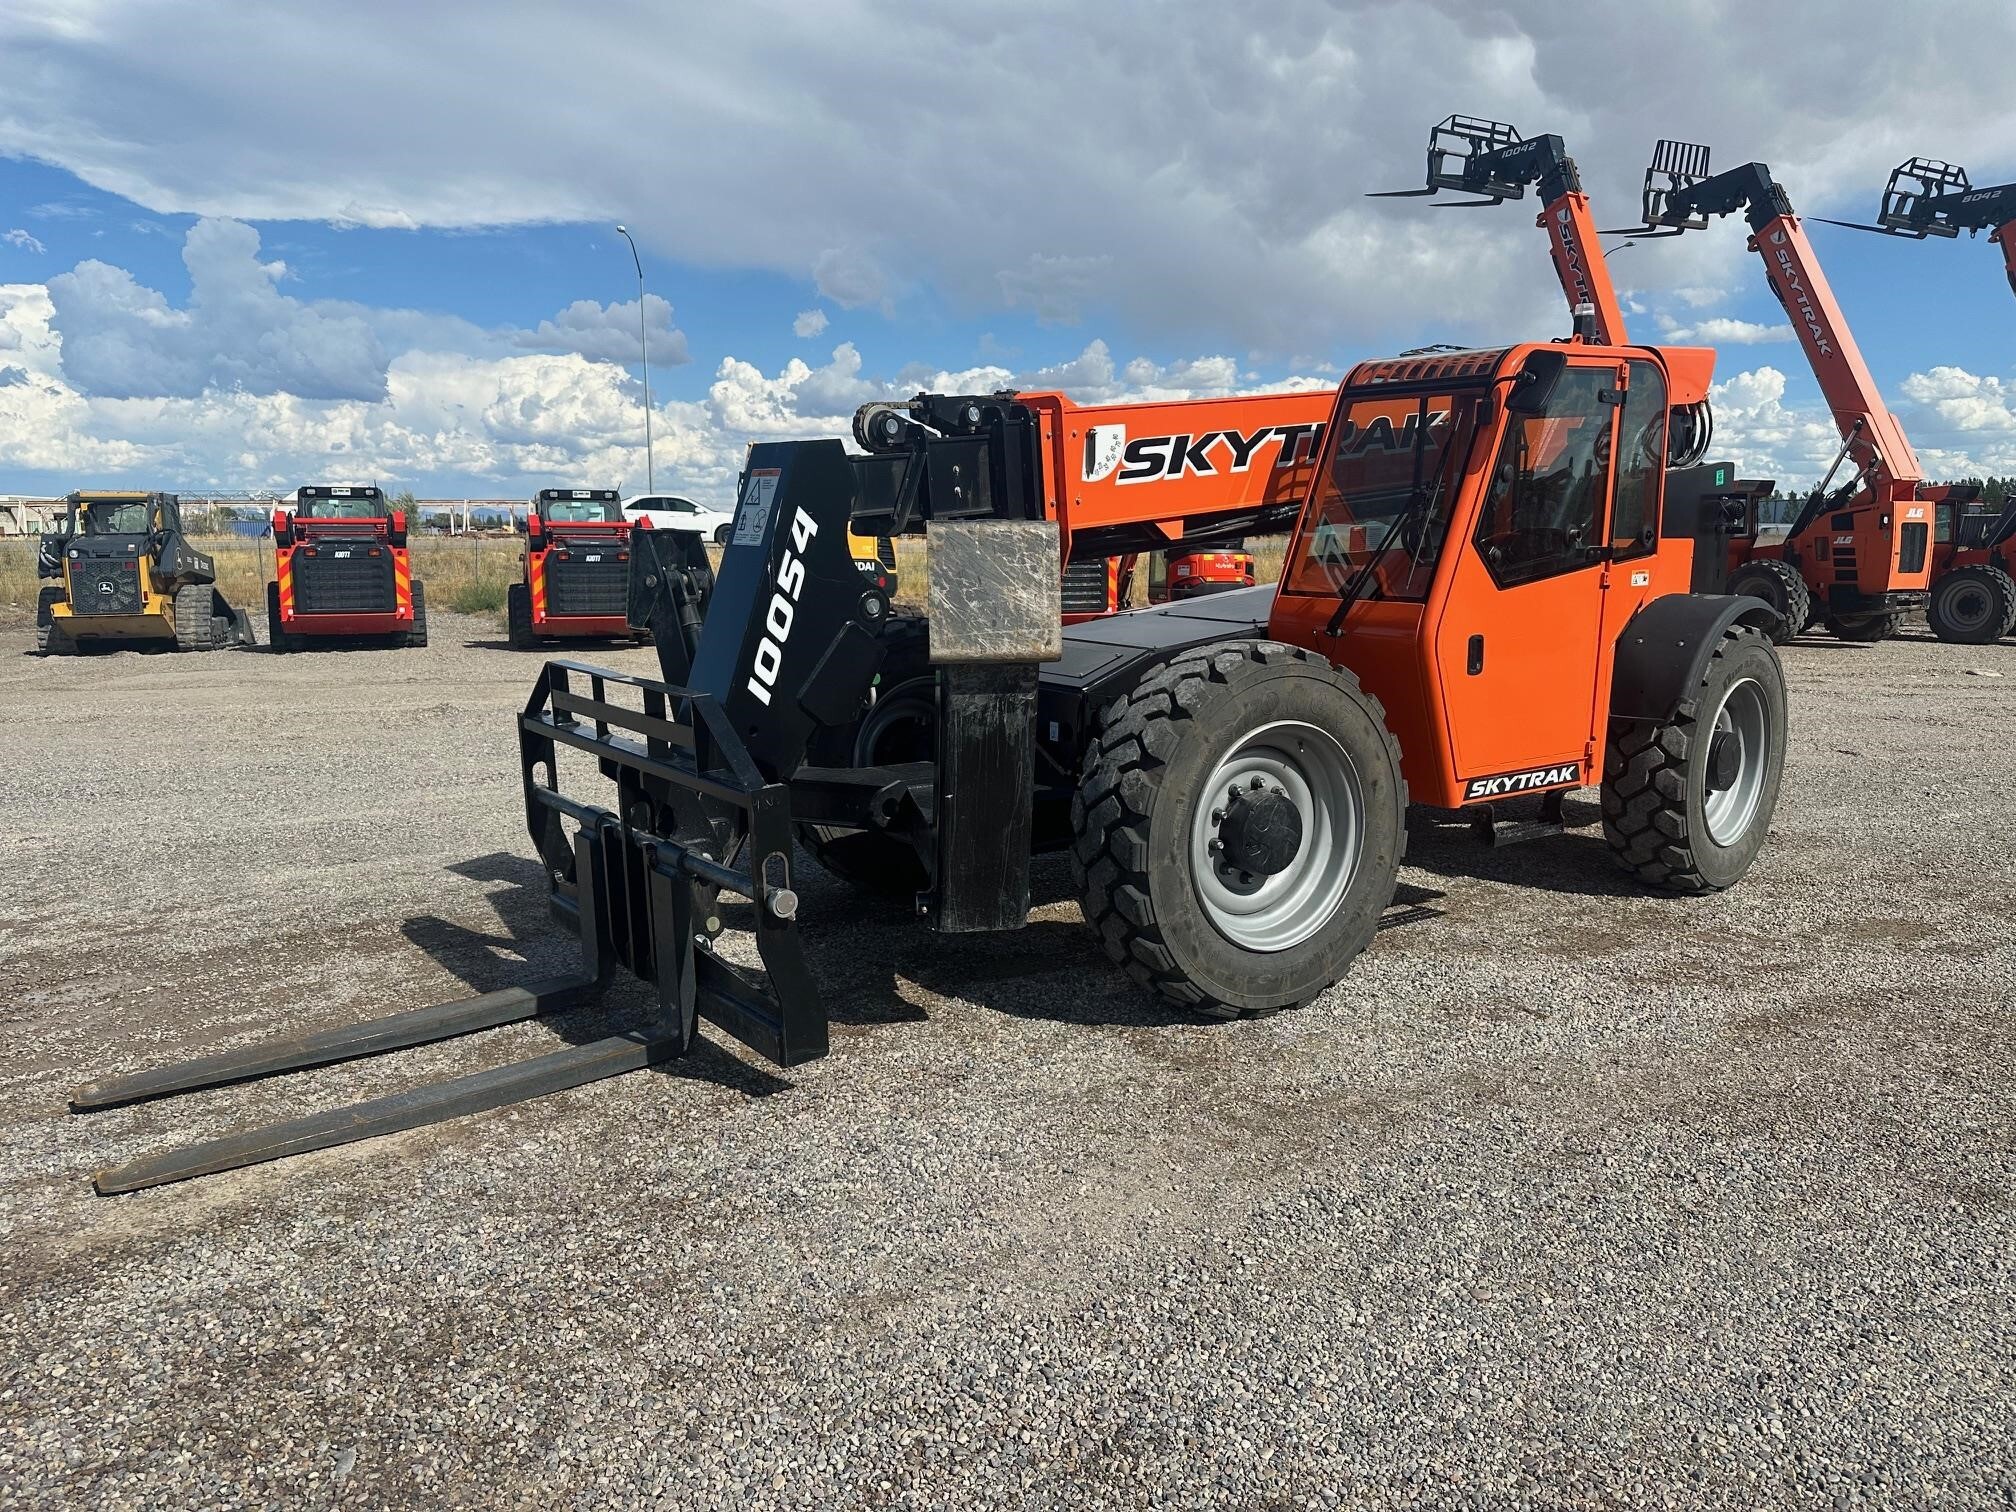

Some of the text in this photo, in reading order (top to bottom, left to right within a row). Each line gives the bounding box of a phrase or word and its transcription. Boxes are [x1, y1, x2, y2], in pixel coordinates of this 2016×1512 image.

[1502, 142, 1537, 159] 10042
[1962, 190, 2002, 203] 8042
[1775, 248, 1833, 358] SKYTRAK
[1906, 508, 1924, 518] JLG
[1834, 536, 1853, 544] JLG
[854, 561, 875, 571] DAI
[747, 505, 819, 706] 10054
[1469, 765, 1576, 797] SKYTRAK
